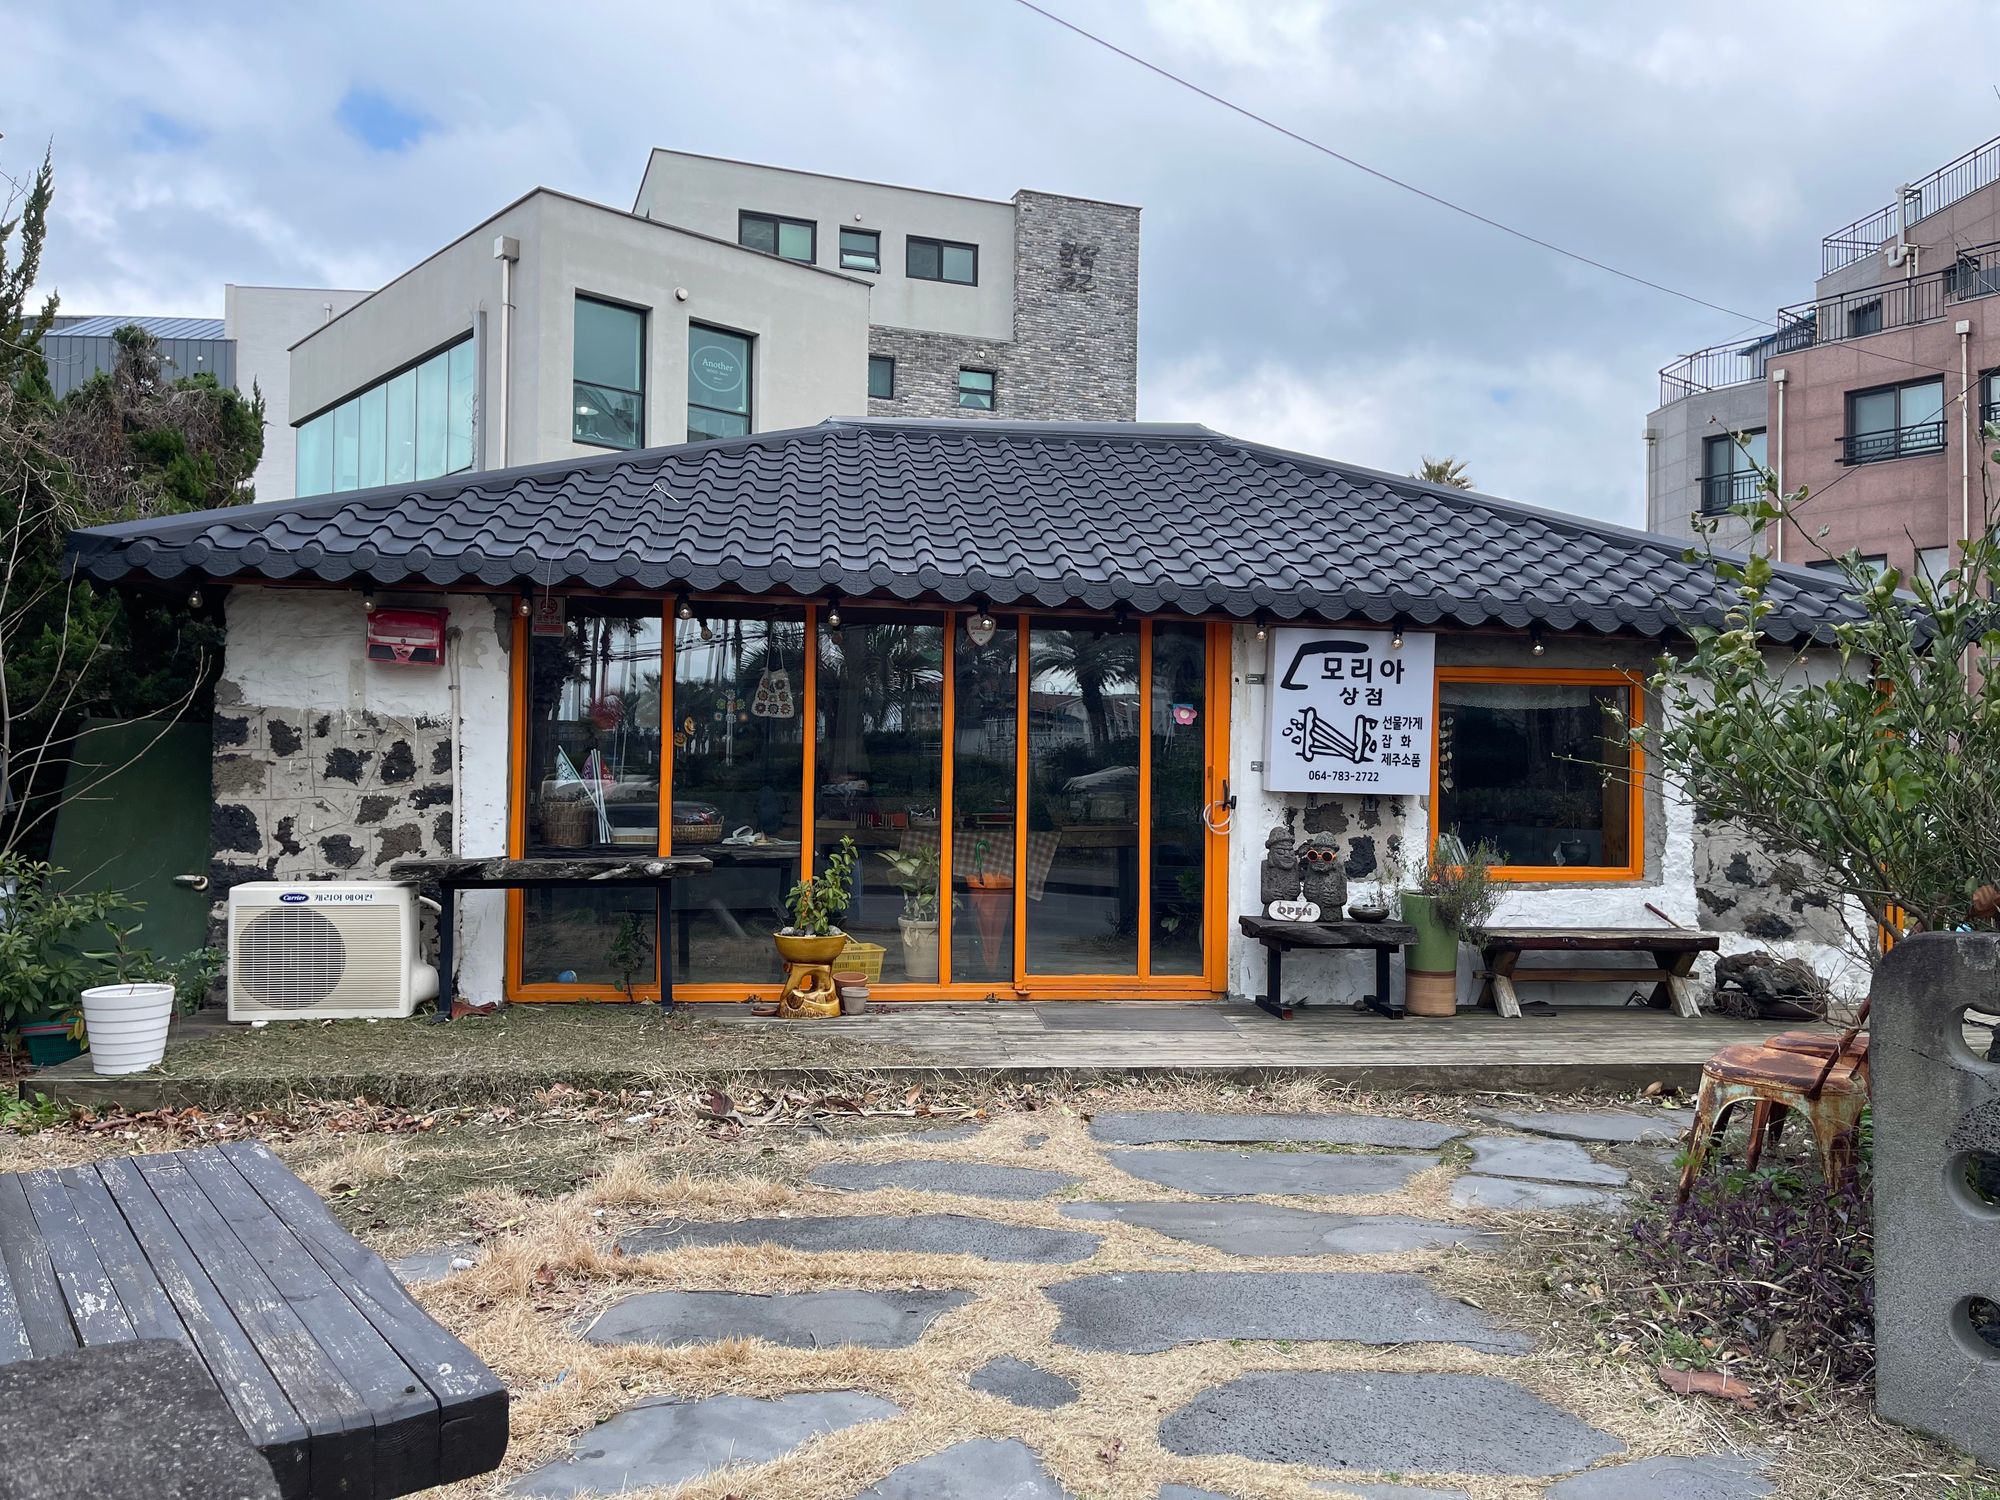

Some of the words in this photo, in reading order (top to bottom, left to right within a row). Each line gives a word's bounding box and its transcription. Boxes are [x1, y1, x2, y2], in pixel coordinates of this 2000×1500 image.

[702, 357, 733, 372] Another
[1321, 657, 1405, 684] 모리아
[1339, 687, 1383, 706] 상점
[1382, 716, 1423, 731] 선물가게
[1381, 753, 1421, 768] 제주소품
[1308, 770, 1379, 782] 064-783-2722
[282, 894, 307, 902] Carrier
[345, 893, 373, 902] 에어컨
[1277, 906, 1312, 917] OPEN
